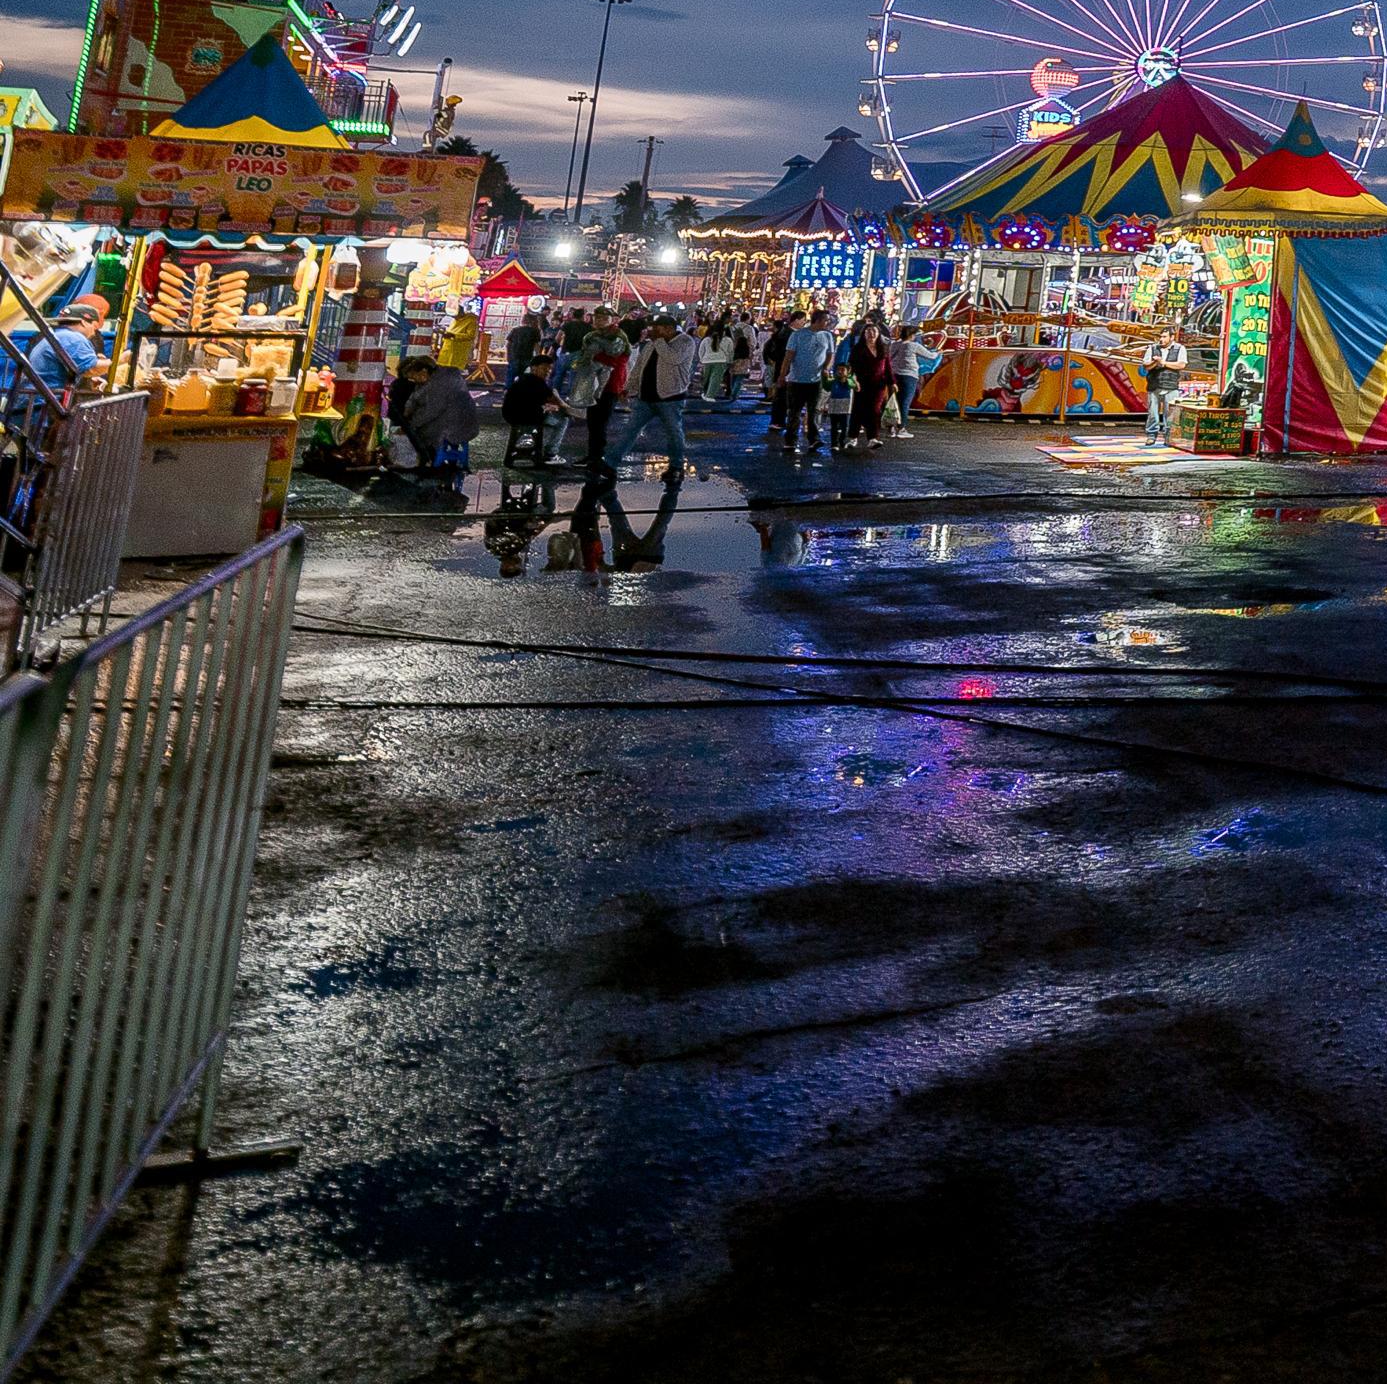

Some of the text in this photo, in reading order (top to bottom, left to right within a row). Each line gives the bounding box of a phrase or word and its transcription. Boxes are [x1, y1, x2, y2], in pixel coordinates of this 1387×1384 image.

[1033, 111, 1071, 123] KIDS
[233, 143, 286, 157] RICAS
[225, 158, 288, 175] PAPAS
[235, 176, 273, 192] LEO
[1137, 280, 1157, 293] 10
[1168, 280, 1189, 293] 10
[1242, 319, 1255, 331] 20
[1239, 343, 1253, 356] 40
